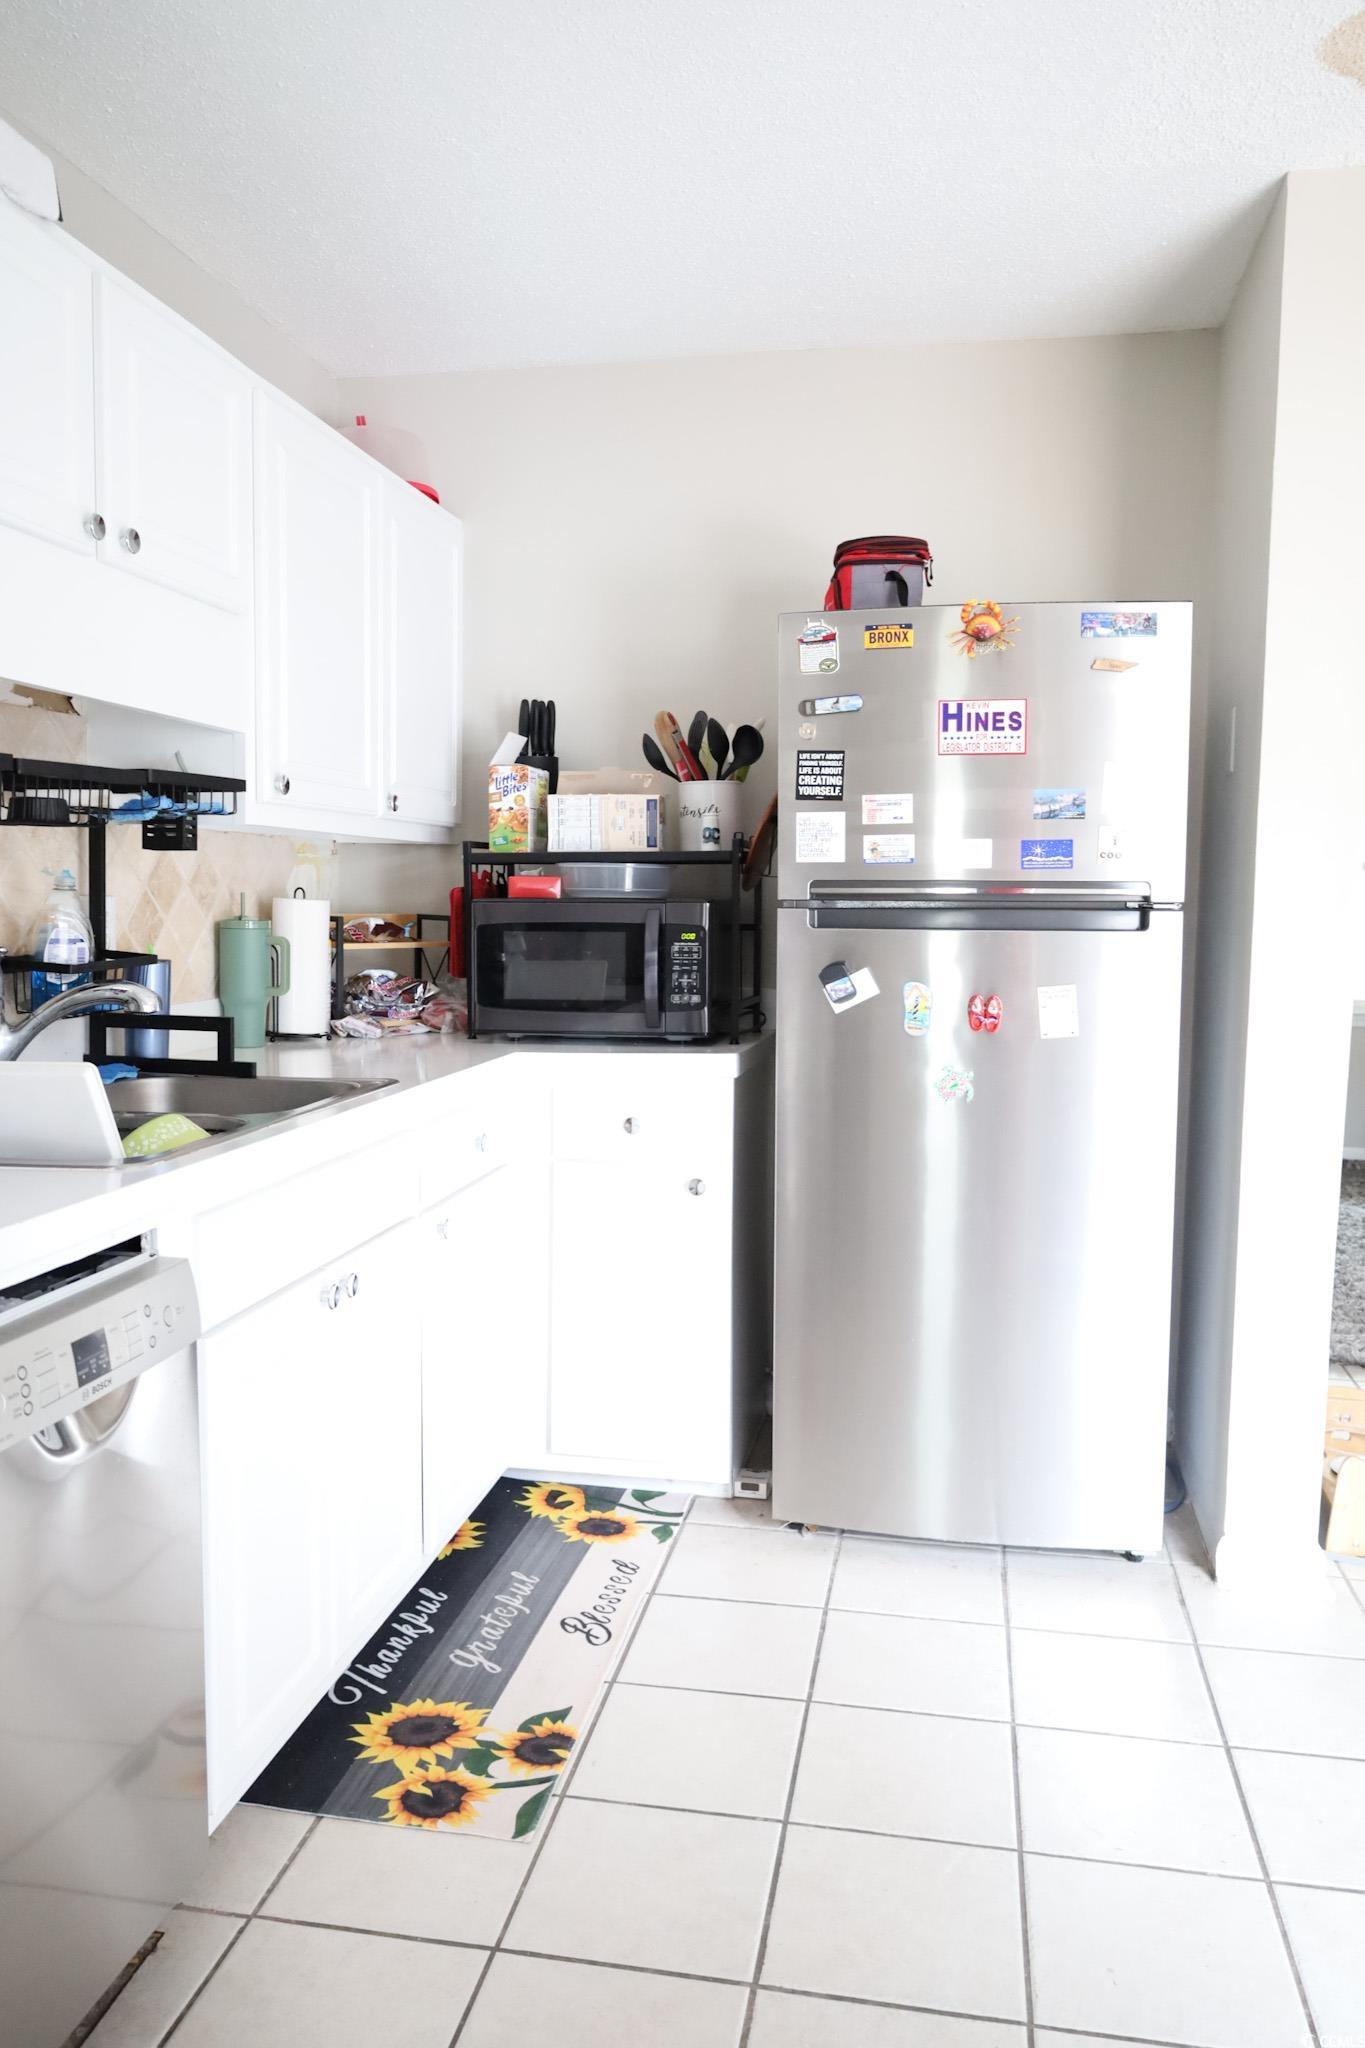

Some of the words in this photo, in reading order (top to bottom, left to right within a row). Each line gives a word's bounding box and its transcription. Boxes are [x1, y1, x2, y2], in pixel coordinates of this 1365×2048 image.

[868, 631, 909, 644] BRONX
[942, 702, 1023, 733] HINES
[976, 733, 988, 741] FOR
[942, 743, 981, 752] LEGISLATOR
[983, 742, 1013, 752] DISTRICT
[798, 767, 813, 775] LIFE
[813, 767, 820, 775] IS
[820, 767, 843, 775] ABOUT
[495, 773, 519, 790] Little
[798, 775, 843, 786] CREATING
[502, 783, 527, 797] Bites
[798, 785, 842, 796] YOURSELF.
[92, 1377, 112, 1394] BOSCH
[560, 1557, 640, 1646] Blessed
[327, 1586, 449, 1705] Thankful
